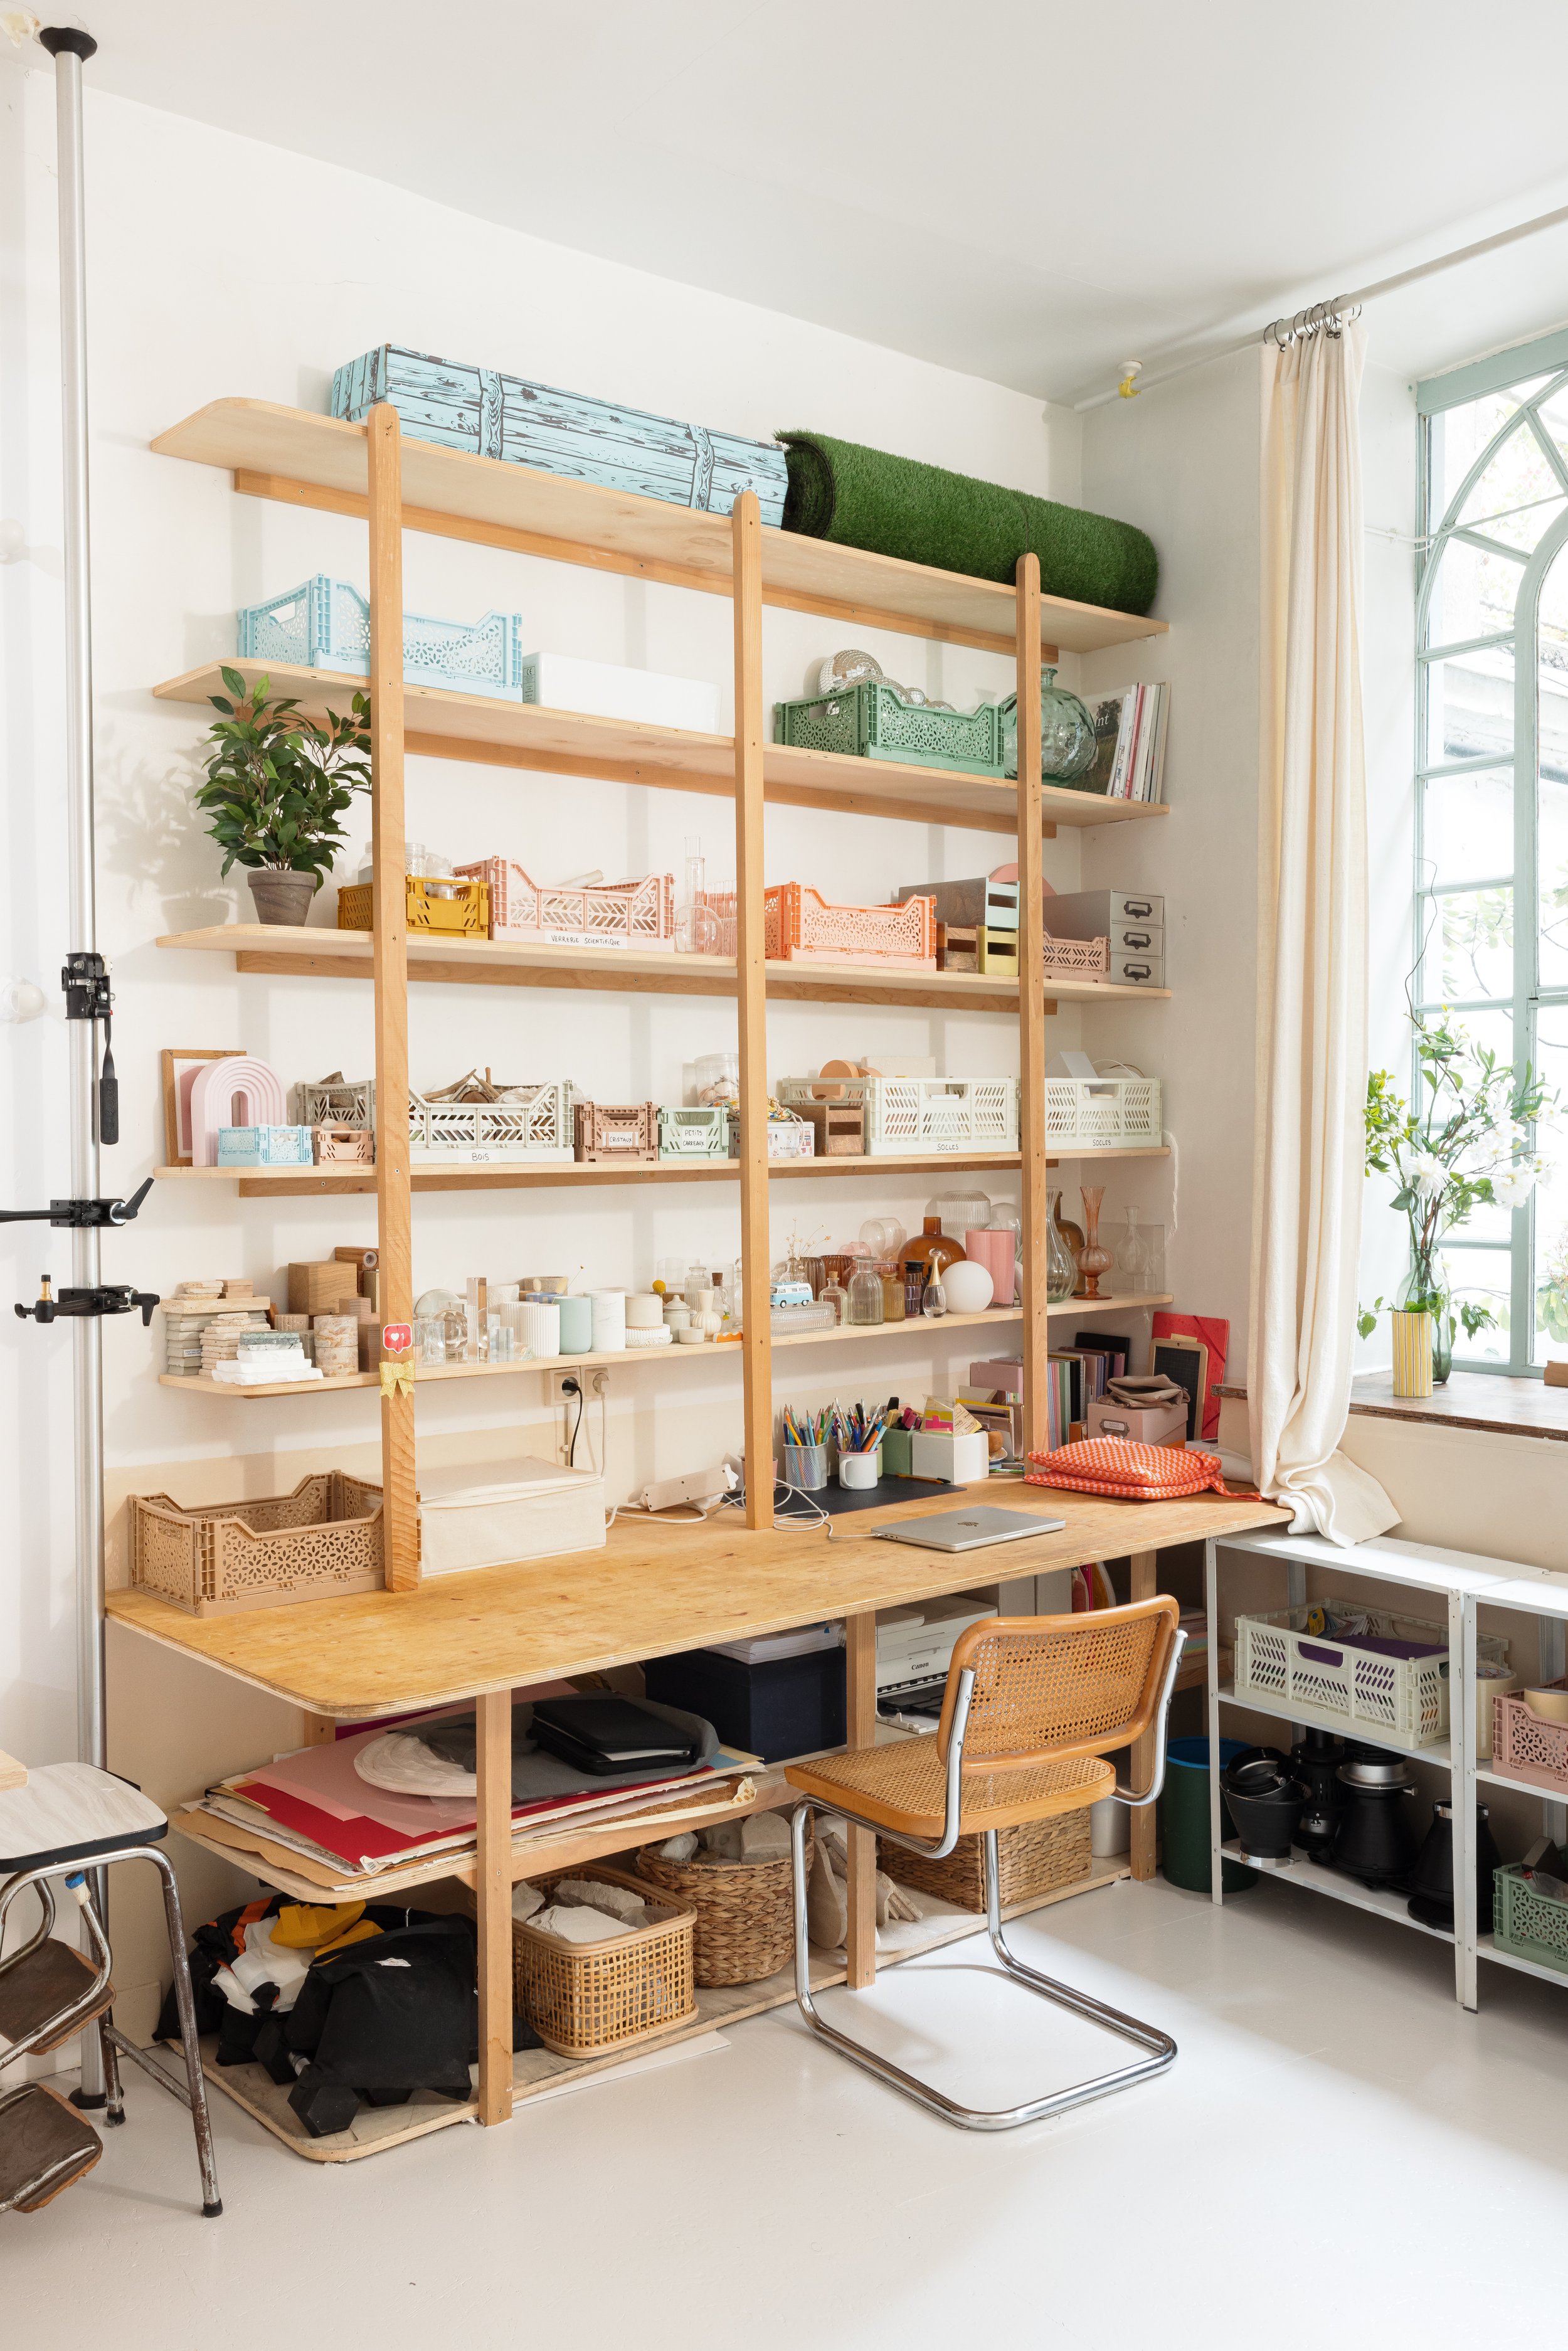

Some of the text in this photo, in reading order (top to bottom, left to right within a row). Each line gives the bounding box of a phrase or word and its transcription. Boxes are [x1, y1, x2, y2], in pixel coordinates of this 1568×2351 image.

[1094, 713, 1110, 727] int
[1093, 1138, 1111, 1147] SOCLES
[936, 1143, 959, 1151] SOCLES
[401, 1332, 405, 1340] 1
[911, 1662, 929, 1670] Canon
